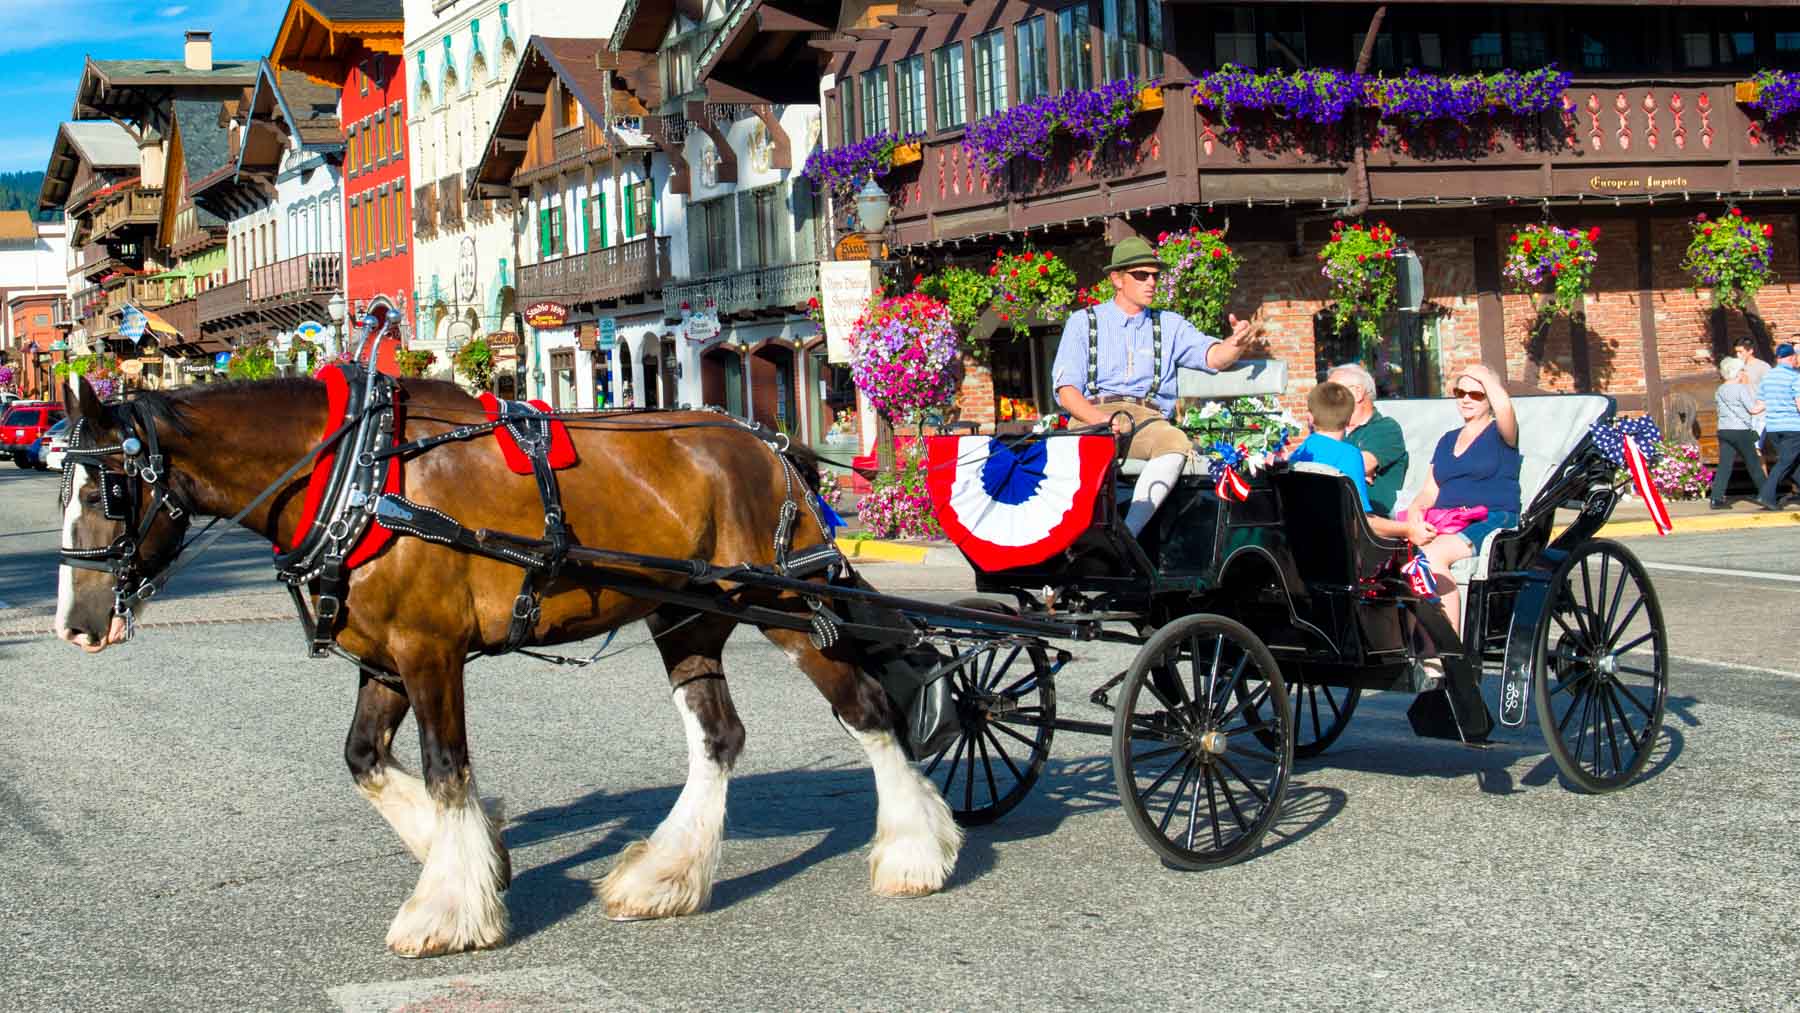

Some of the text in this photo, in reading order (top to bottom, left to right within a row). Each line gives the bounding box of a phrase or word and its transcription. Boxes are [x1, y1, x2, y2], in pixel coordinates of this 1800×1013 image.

[1590, 176, 1687, 189] European Imports
[526, 303, 549, 319] Studio
